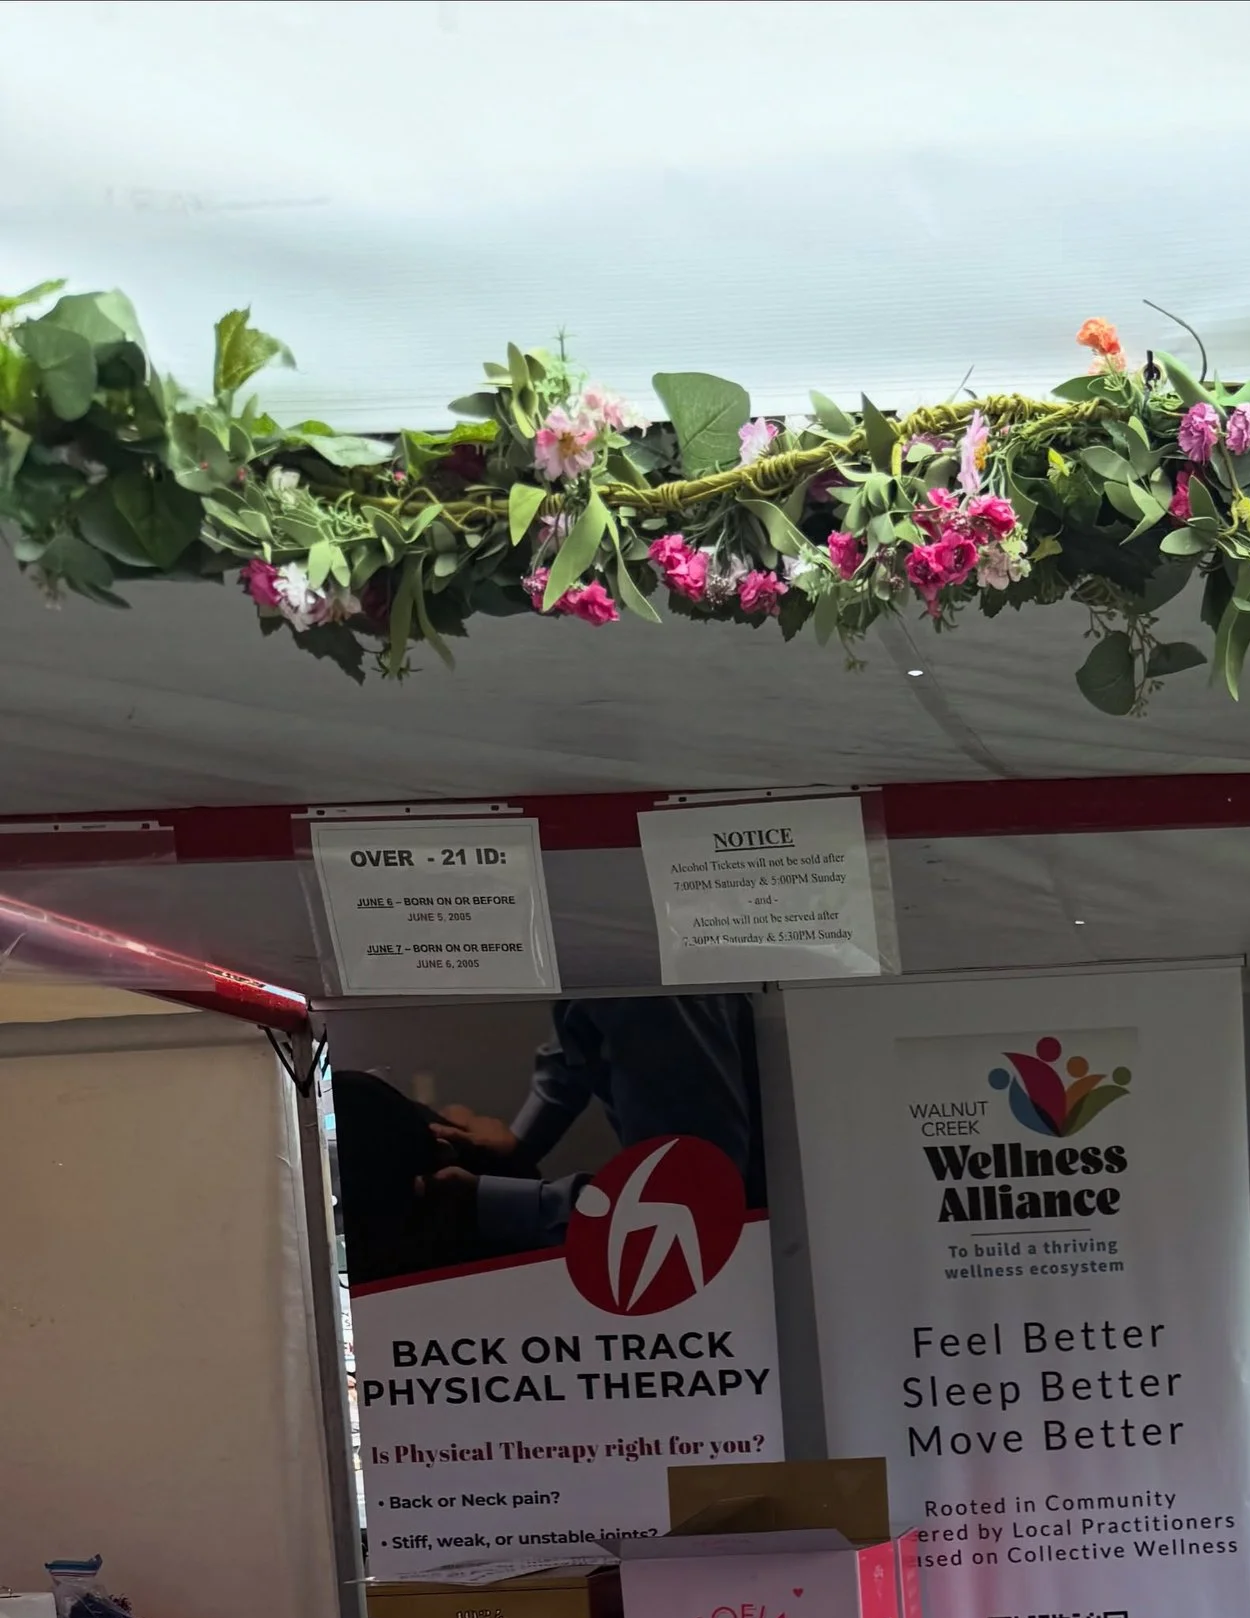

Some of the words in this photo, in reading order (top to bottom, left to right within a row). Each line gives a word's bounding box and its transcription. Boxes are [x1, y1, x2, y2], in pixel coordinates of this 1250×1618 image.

[713, 828, 794, 849] NOTICE
[350, 850, 414, 867] OVER
[441, 849, 466, 865] 21
[476, 848, 507, 865] ID:
[671, 861, 708, 874] Alcohol
[710, 859, 746, 871] Tickets
[748, 857, 766, 869] will
[769, 857, 784, 867] not
[787, 856, 798, 866] be
[801, 854, 820, 865] sold
[823, 853, 845, 863] after
[357, 898, 384, 908] JUNE
[387, 898, 393, 907] 6
[404, 897, 434, 906] BORN
[437, 897, 452, 906] ON
[455, 896, 470, 905] OR
[473, 896, 515, 905] BEFORE
[407, 913, 434, 922] JUNE
[449, 913, 472, 921] 2005
[367, 945, 393, 954] JUNE
[396, 945, 402, 954] 7
[413, 944, 443, 953] BORN
[445, 944, 460, 953] ON
[463, 944, 478, 952] OR
[481, 943, 523, 952] BEFORE
[909, 1100, 990, 1119] WALNUT
[921, 1120, 980, 1137] CREEK
[922, 1142, 1128, 1182] Wellness
[937, 1184, 1122, 1223] Alliance
[948, 1244, 968, 1259] To
[974, 1241, 1021, 1258] build
[1027, 1244, 1037, 1255] a
[1042, 1238, 1119, 1255] thriving
[944, 1263, 1024, 1280] wellness
[1029, 1259, 1125, 1278] ecosystem
[392, 1337, 508, 1368] BACK
[520, 1335, 582, 1365] ON
[595, 1331, 735, 1361] TRACK
[912, 1323, 1002, 1359] Feel
[1023, 1320, 1166, 1354] Better
[363, 1373, 566, 1407] PHYSICAL
[577, 1368, 771, 1401] THERAPY
[903, 1375, 1021, 1411] Sleep
[1040, 1369, 1183, 1402] Better
[908, 1425, 1024, 1457] Move
[1044, 1418, 1184, 1451] Better
[371, 1446, 389, 1465] Is
[395, 1441, 493, 1470] Physical
[499, 1440, 600, 1465] Therapy
[604, 1437, 663, 1462] right
[668, 1435, 705, 1456] for
[709, 1434, 766, 1459] you?
[389, 1494, 433, 1510] Back
[437, 1496, 457, 1509] or
[461, 1492, 507, 1508] Neck
[512, 1490, 561, 1509] pain?
[925, 1497, 1006, 1517] Rooted
[1016, 1497, 1036, 1513] in
[1045, 1490, 1177, 1512] Community
[917, 1524, 969, 1543] ered
[978, 1523, 1003, 1543] by
[1012, 1519, 1072, 1538] Local
[1082, 1514, 1236, 1535] Practitioners
[392, 1535, 432, 1551] Stiff,
[436, 1533, 491, 1548] weak,
[495, 1534, 513, 1546] or
[518, 1531, 595, 1545] unstable
[917, 1549, 962, 1568] sed
[971, 1551, 998, 1565] on
[1007, 1542, 1126, 1564] Collective
[1133, 1538, 1238, 1558] Wellness
